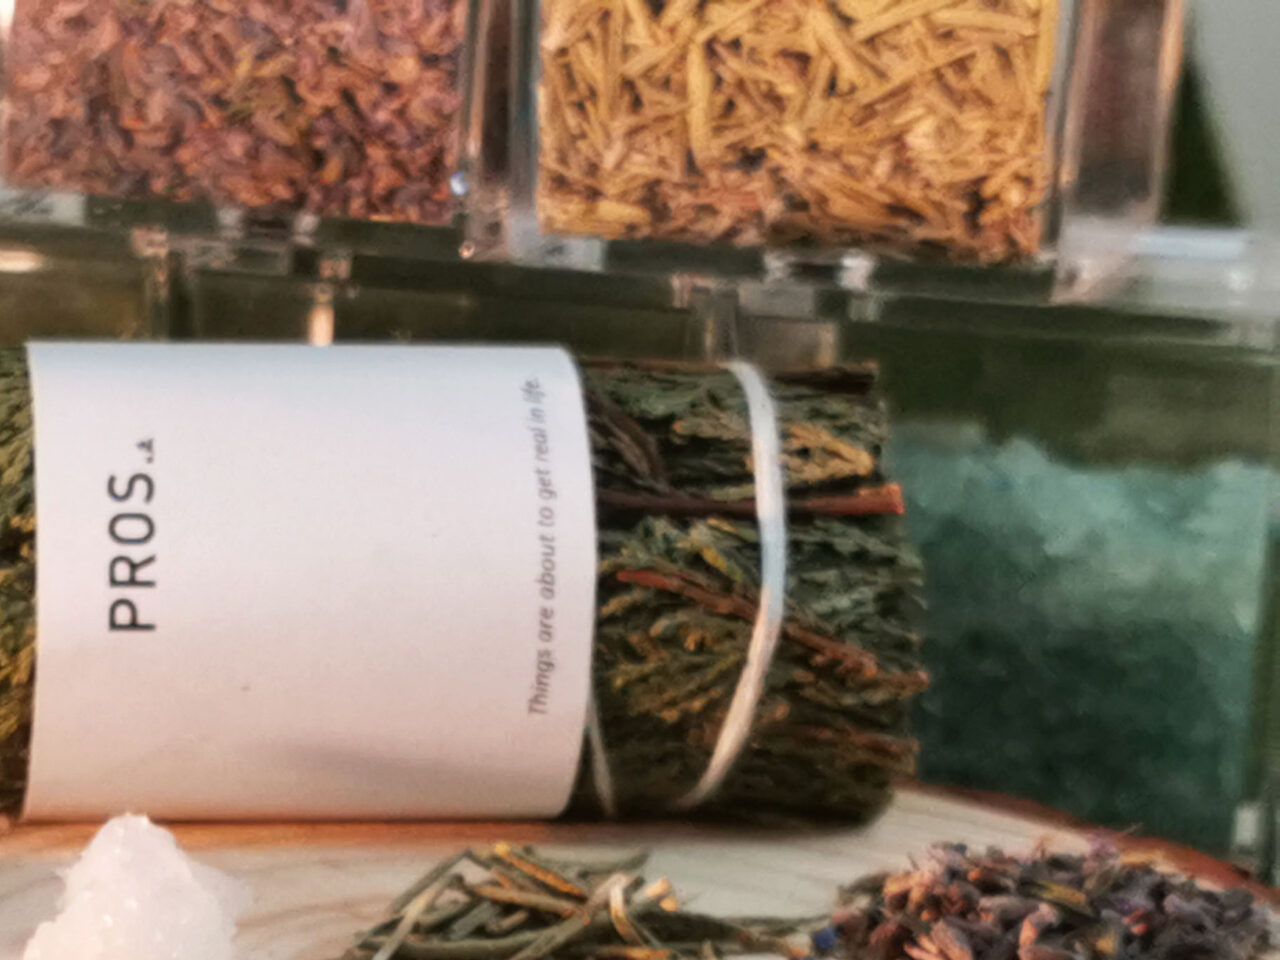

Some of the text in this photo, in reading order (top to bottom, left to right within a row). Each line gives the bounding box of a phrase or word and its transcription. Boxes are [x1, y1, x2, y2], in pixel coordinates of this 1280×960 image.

[528, 408, 545, 424] in
[527, 427, 549, 462] real
[535, 468, 558, 500] get
[535, 507, 554, 527] to
[535, 535, 556, 600] about
[538, 606, 556, 643] are
[528, 649, 556, 716] Things
